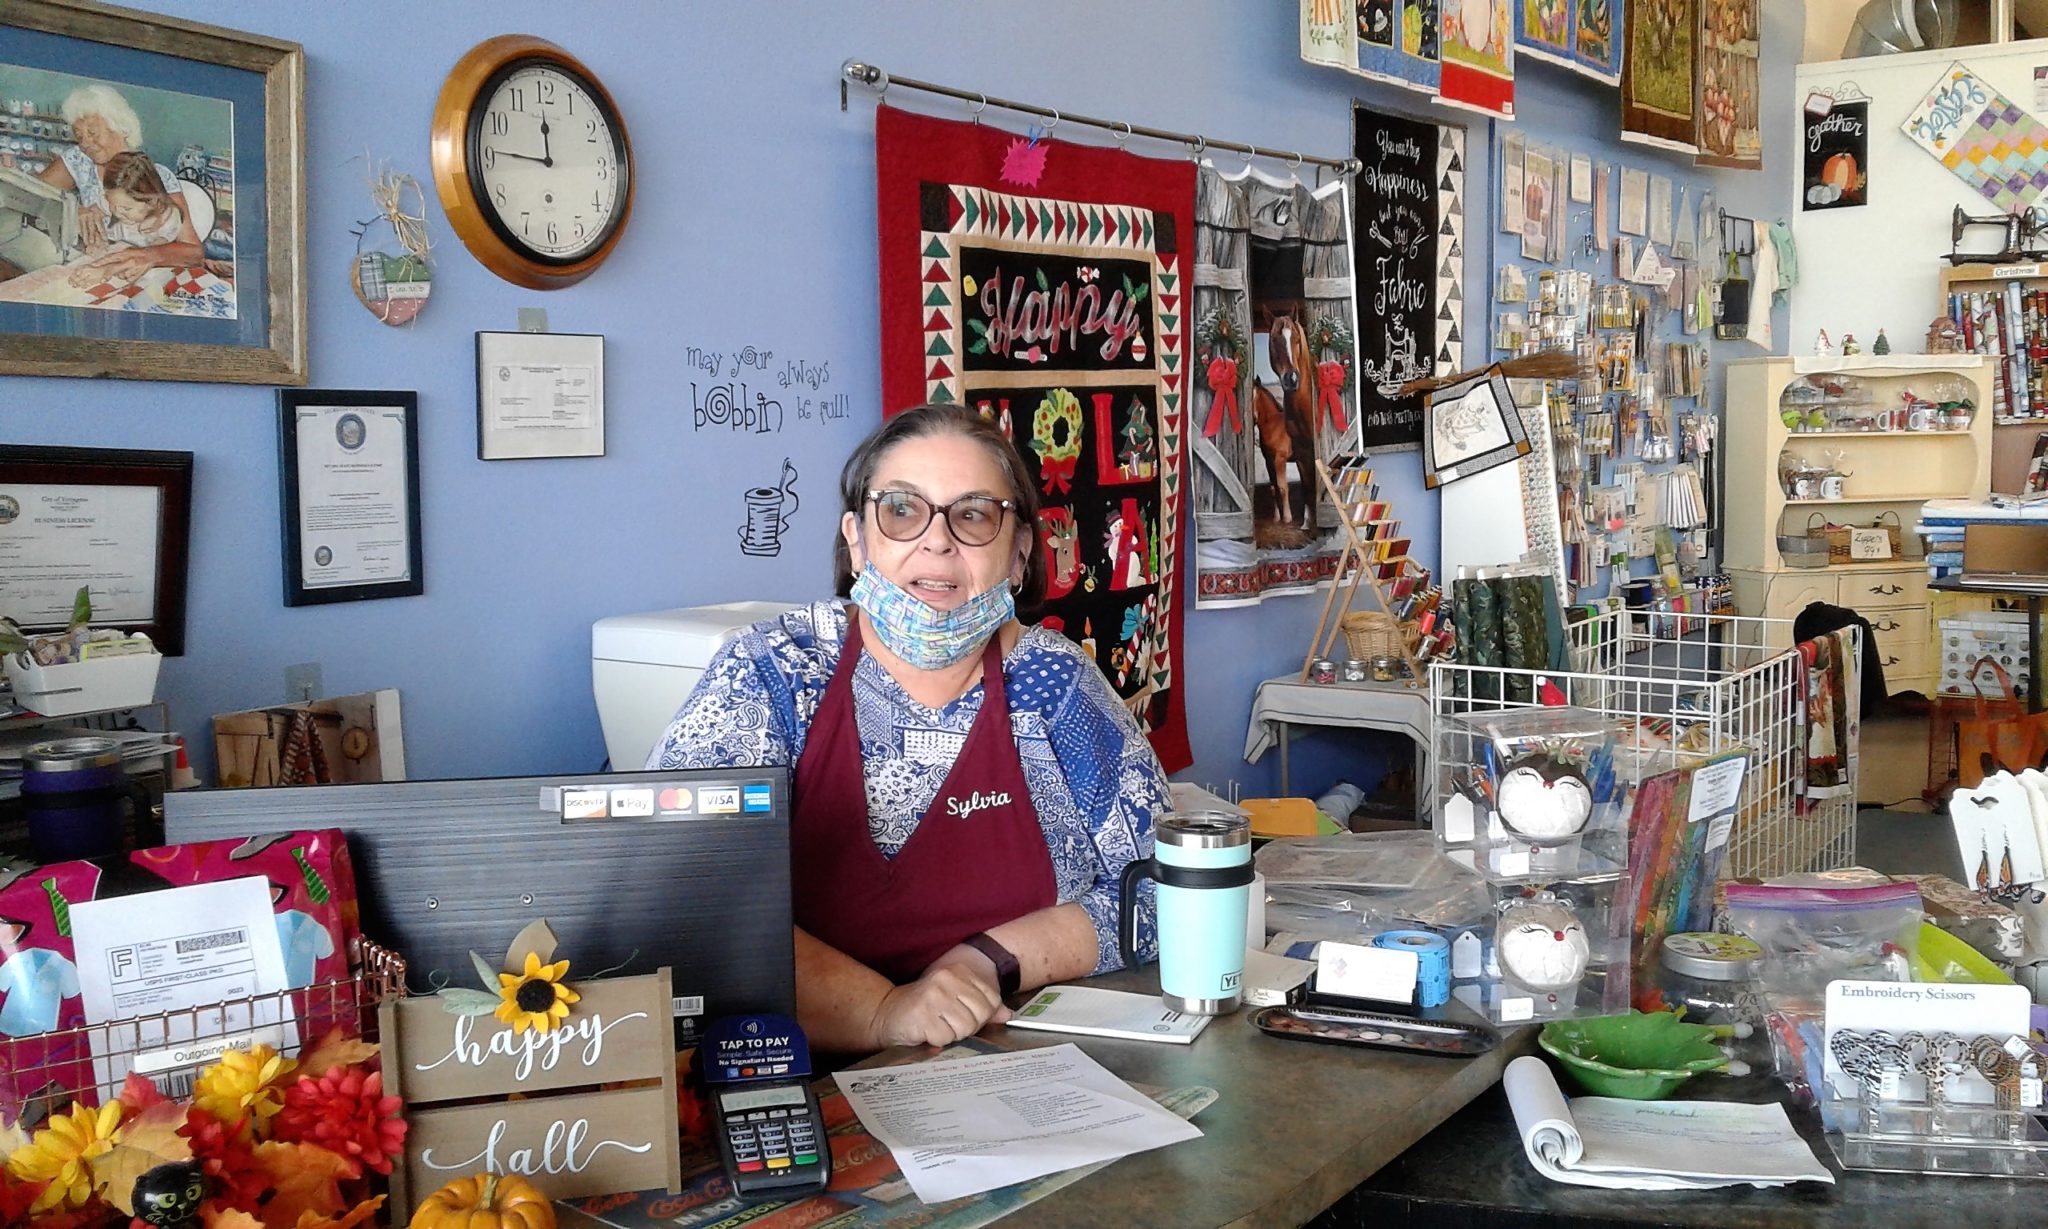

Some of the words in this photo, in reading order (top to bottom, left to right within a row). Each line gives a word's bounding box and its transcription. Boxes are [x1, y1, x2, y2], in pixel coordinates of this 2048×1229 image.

[510, 88, 525, 112] 11
[537, 81, 554, 104] 12
[567, 93, 573, 115] 1
[490, 111, 508, 136] 10
[587, 119, 597, 143] 2
[1808, 113, 1863, 152] gather
[485, 145, 495, 170] 9
[597, 157, 607, 181] 3
[1365, 160, 1429, 202] Happiness
[496, 184, 507, 208] 8
[592, 189, 602, 212] 4
[521, 211, 530, 235] 7
[547, 222, 557, 245] 6
[574, 215, 584, 238] 5
[1374, 254, 1427, 316] Fabric
[981, 265, 1140, 361] Happy
[690, 382, 783, 433] bobbin
[706, 795, 734, 805] VISA
[947, 790, 1012, 819] Sylvia
[111, 948, 132, 977] F
[1841, 985, 1922, 1002] Embroidery
[1925, 988, 1976, 1001] Scissors
[174, 1044, 226, 1063] Outgoing
[416, 1011, 648, 1081] happy
[720, 1040, 744, 1050] TAP
[746, 1038, 763, 1048] TO
[766, 1036, 789, 1047] PAY
[422, 1118, 652, 1177] fall
